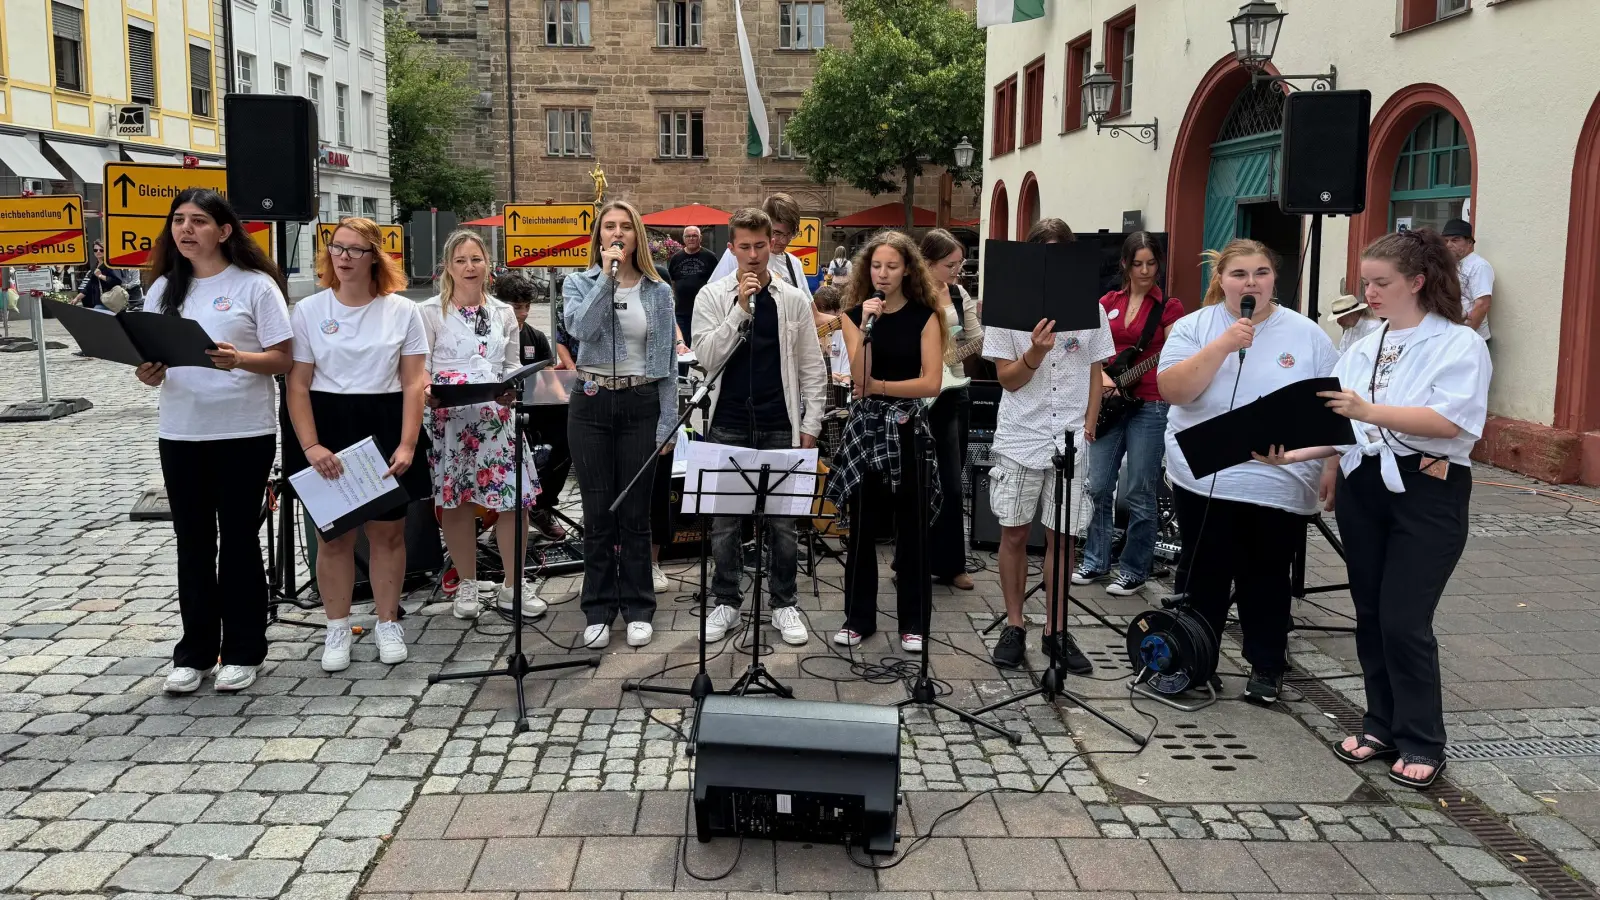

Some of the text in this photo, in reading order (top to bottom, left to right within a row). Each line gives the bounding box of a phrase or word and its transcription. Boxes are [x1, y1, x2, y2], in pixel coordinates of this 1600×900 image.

[119, 125, 145, 134] rosset
[328, 151, 350, 168] BANK
[0, 209, 62, 219] eichbehandlung
[522, 216, 578, 225] Gleichbehandlung
[0, 240, 76, 254] assismus
[513, 244, 588, 257] Rassismus
